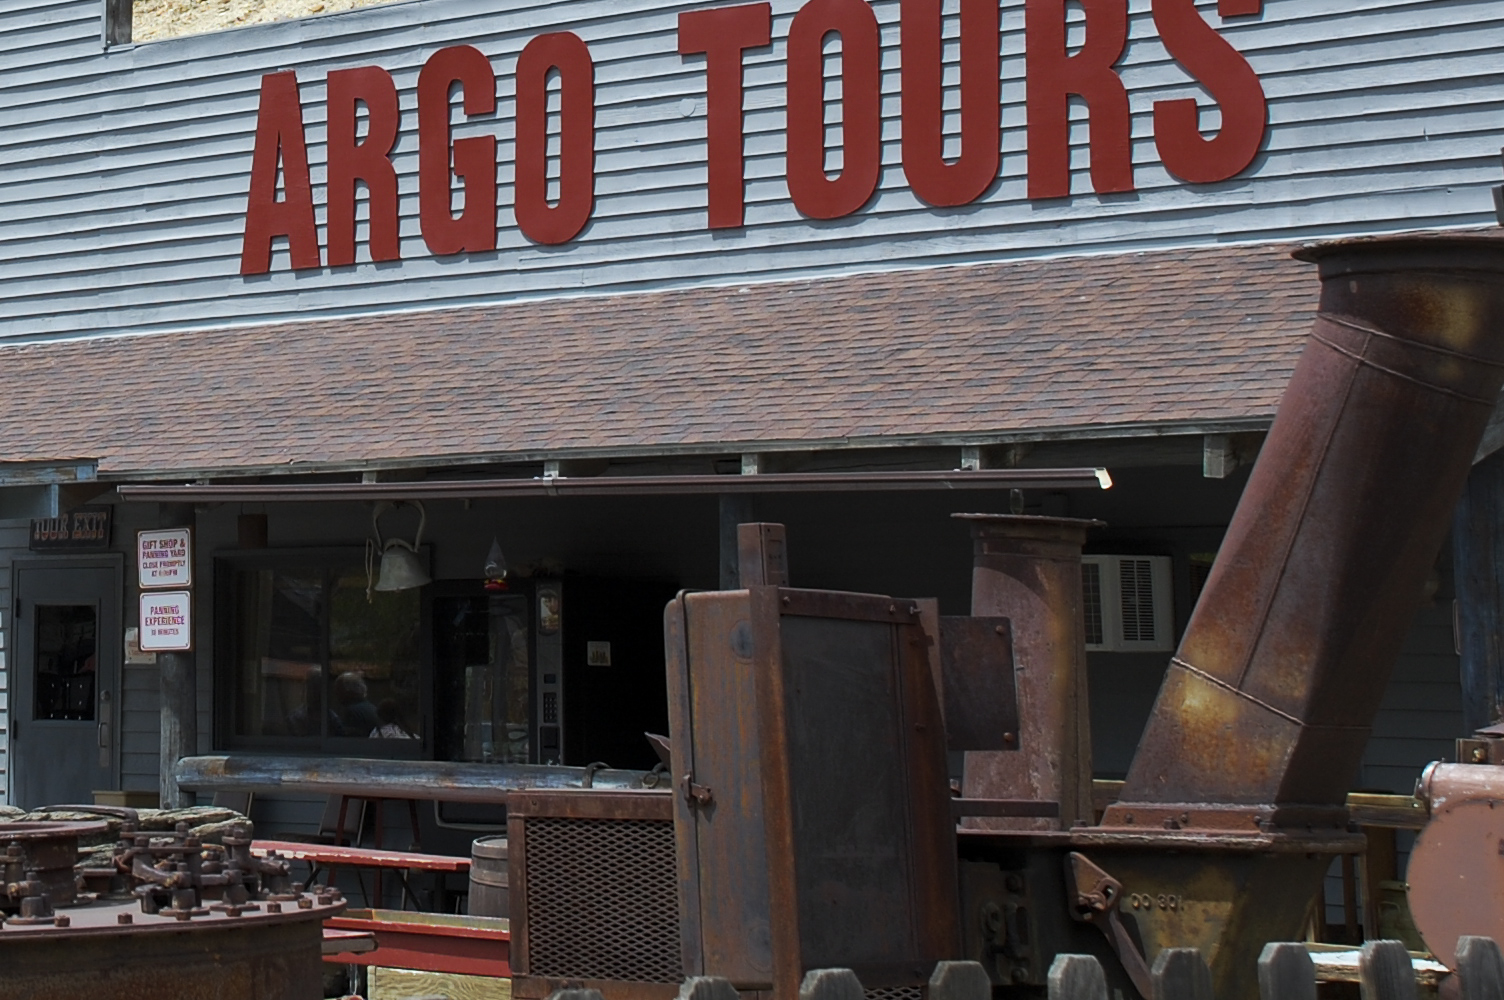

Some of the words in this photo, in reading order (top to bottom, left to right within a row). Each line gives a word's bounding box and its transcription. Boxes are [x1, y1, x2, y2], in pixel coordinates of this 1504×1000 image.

[240, 31, 595, 276] ARGO
[72, 512, 106, 539] EXIT
[142, 540, 157, 549] GIFT
[159, 538, 178, 549] SHOP
[180, 538, 186, 548] &
[142, 550, 168, 559] PANNING
[150, 605, 179, 615] PANNING
[145, 616, 185, 626] EXPERIENCE
